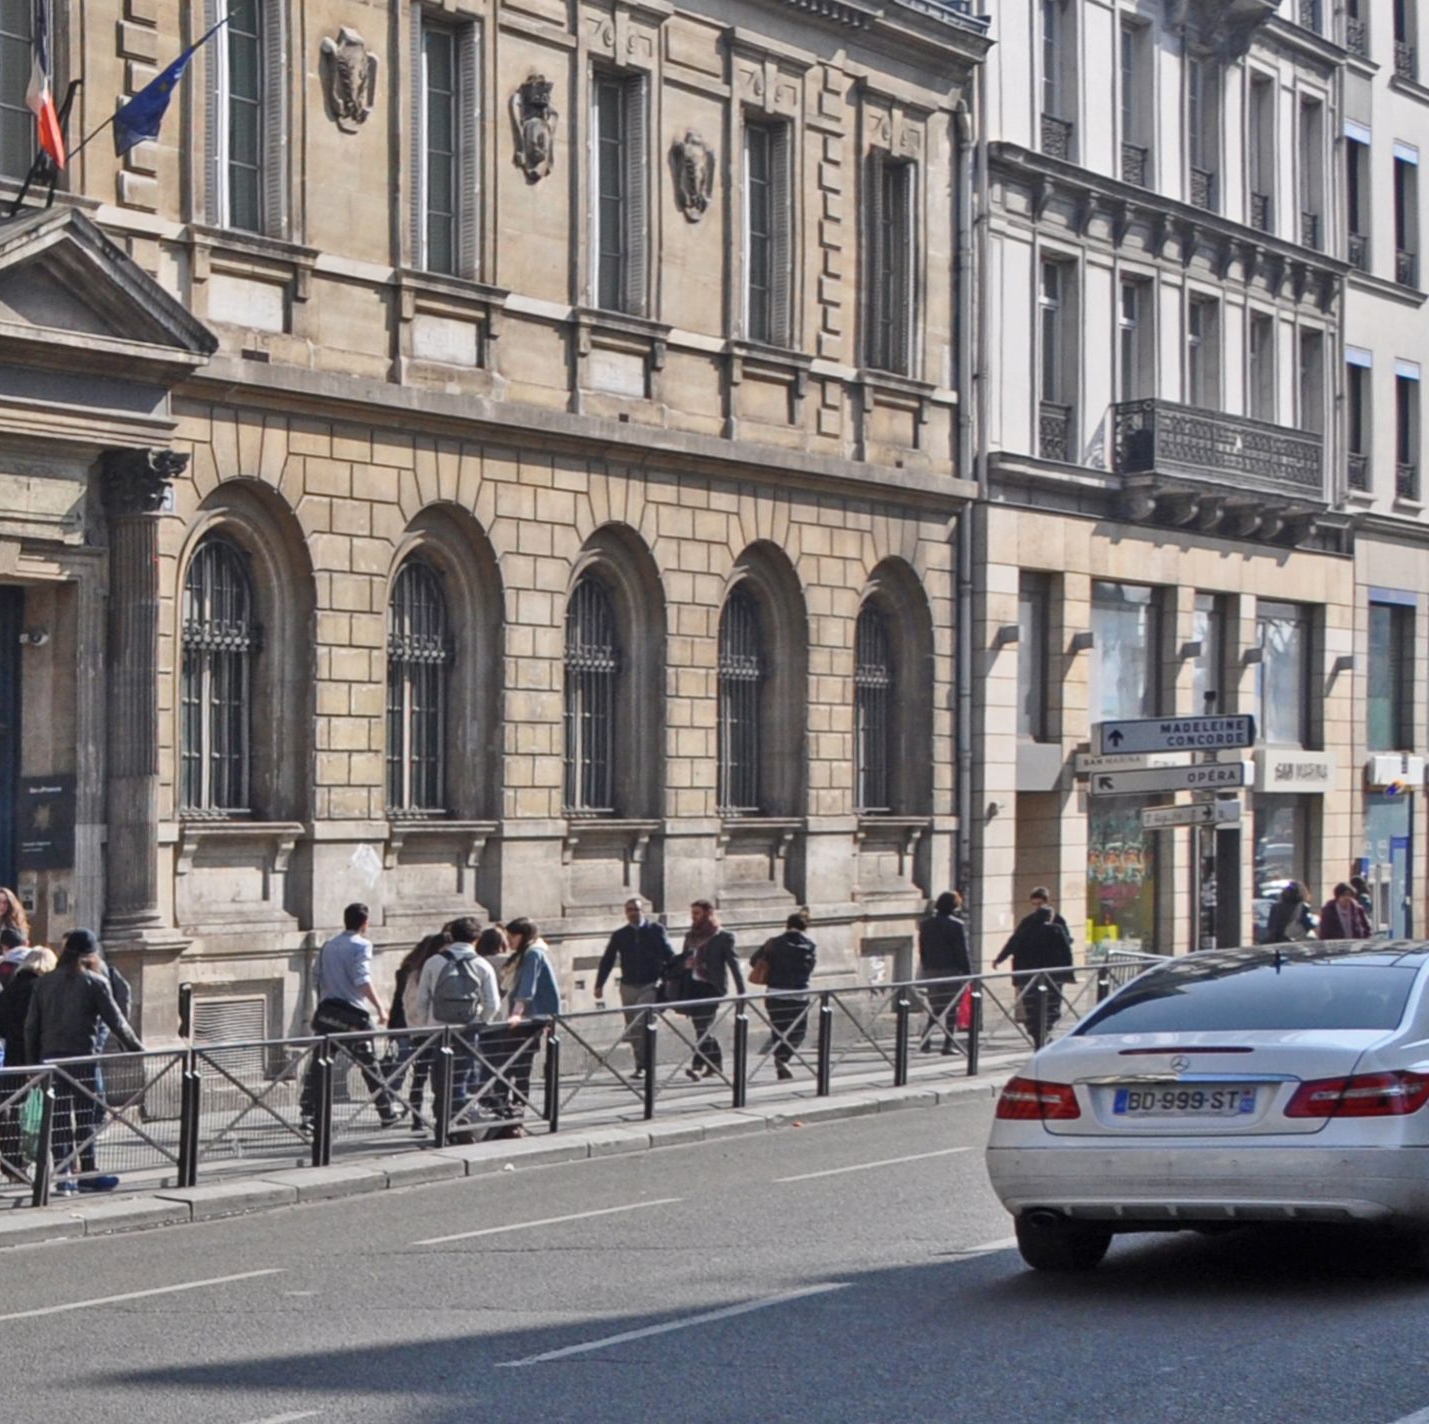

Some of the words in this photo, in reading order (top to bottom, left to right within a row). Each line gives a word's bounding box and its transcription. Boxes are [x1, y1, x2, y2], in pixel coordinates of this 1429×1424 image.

[1160, 720, 1245, 734] MADELEINE
[1166, 733, 1245, 746] CONCORDE
[1187, 769, 1236, 783] OPÉRA
[1127, 1091, 1239, 1110] BD-999-ST
